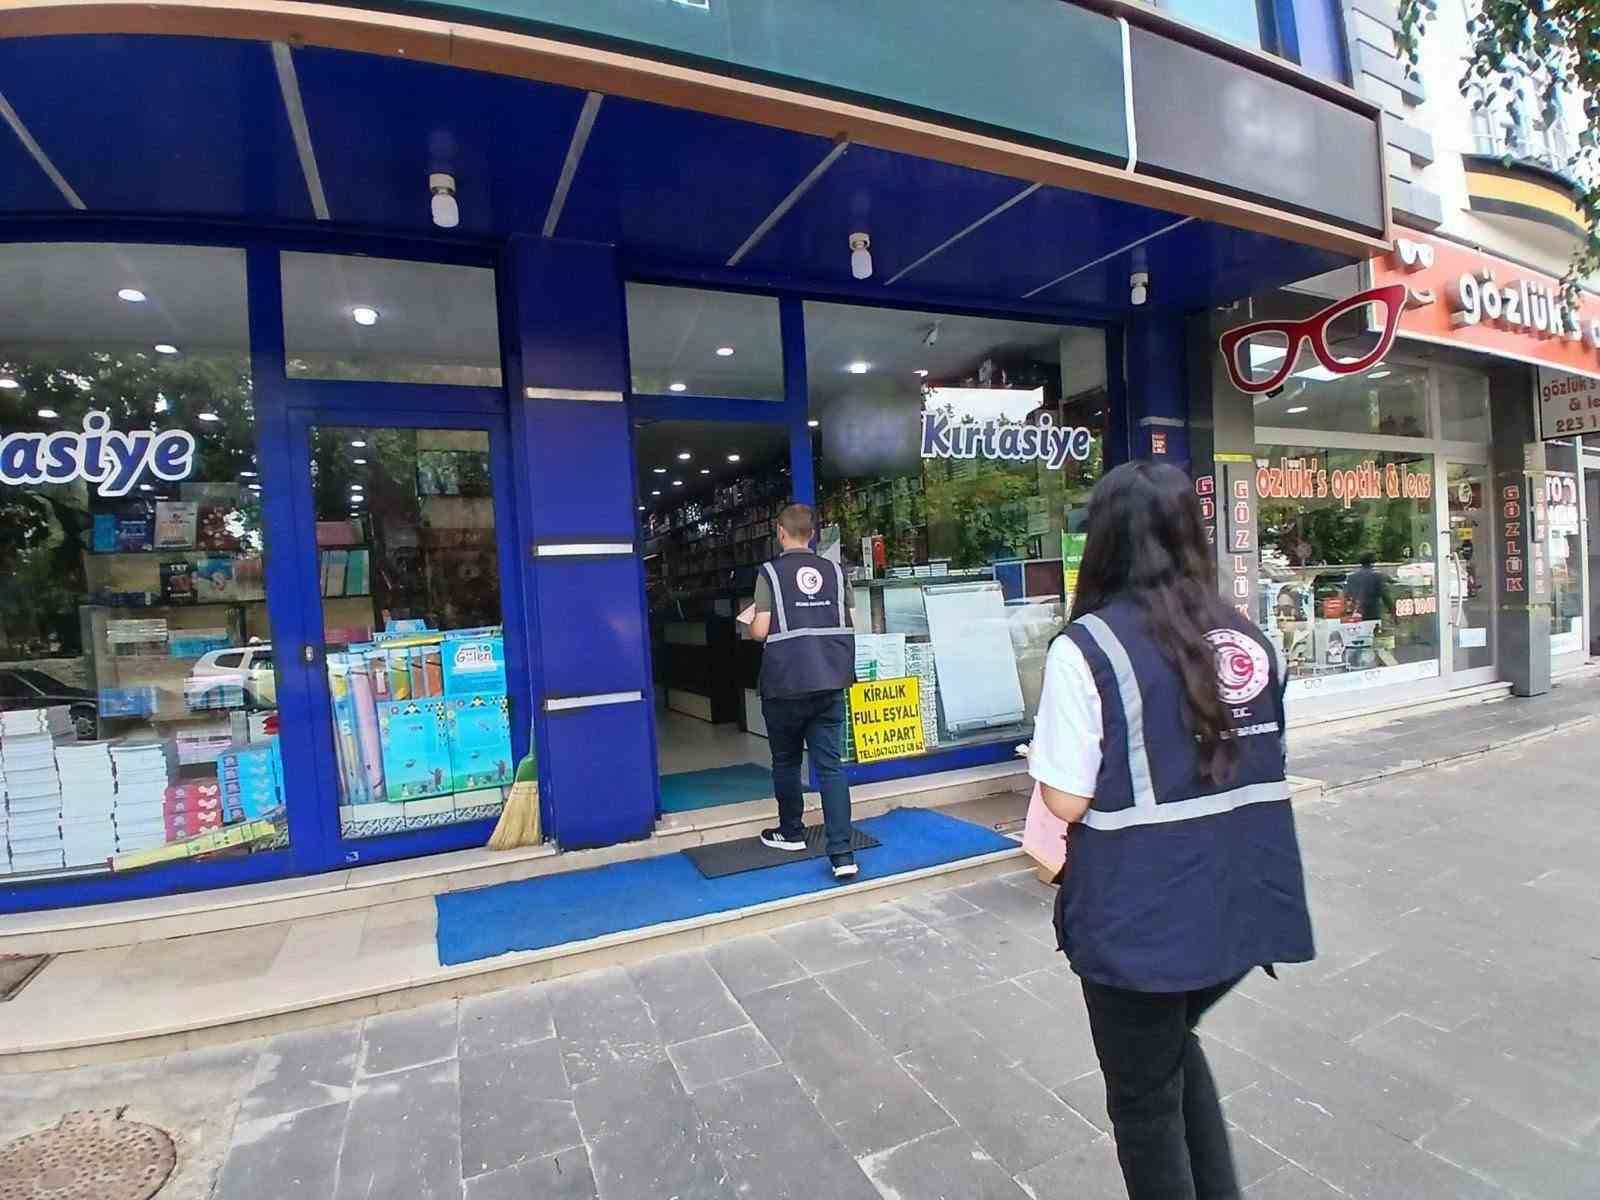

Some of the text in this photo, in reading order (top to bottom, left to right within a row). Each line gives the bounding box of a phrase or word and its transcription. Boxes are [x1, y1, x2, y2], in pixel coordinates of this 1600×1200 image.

[1556, 416, 1584, 433] 223
[921, 412, 1091, 470] Kırtasiye
[1331, 461, 1381, 508] optik
[1385, 463, 1399, 497] &
[1401, 463, 1432, 498] lens
[1503, 485, 1524, 592] GÖZLÜK
[864, 684, 906, 702] KİRALIK
[854, 704, 919, 726] FULL EŞYALI
[862, 726, 916, 747] 1+1 APART
